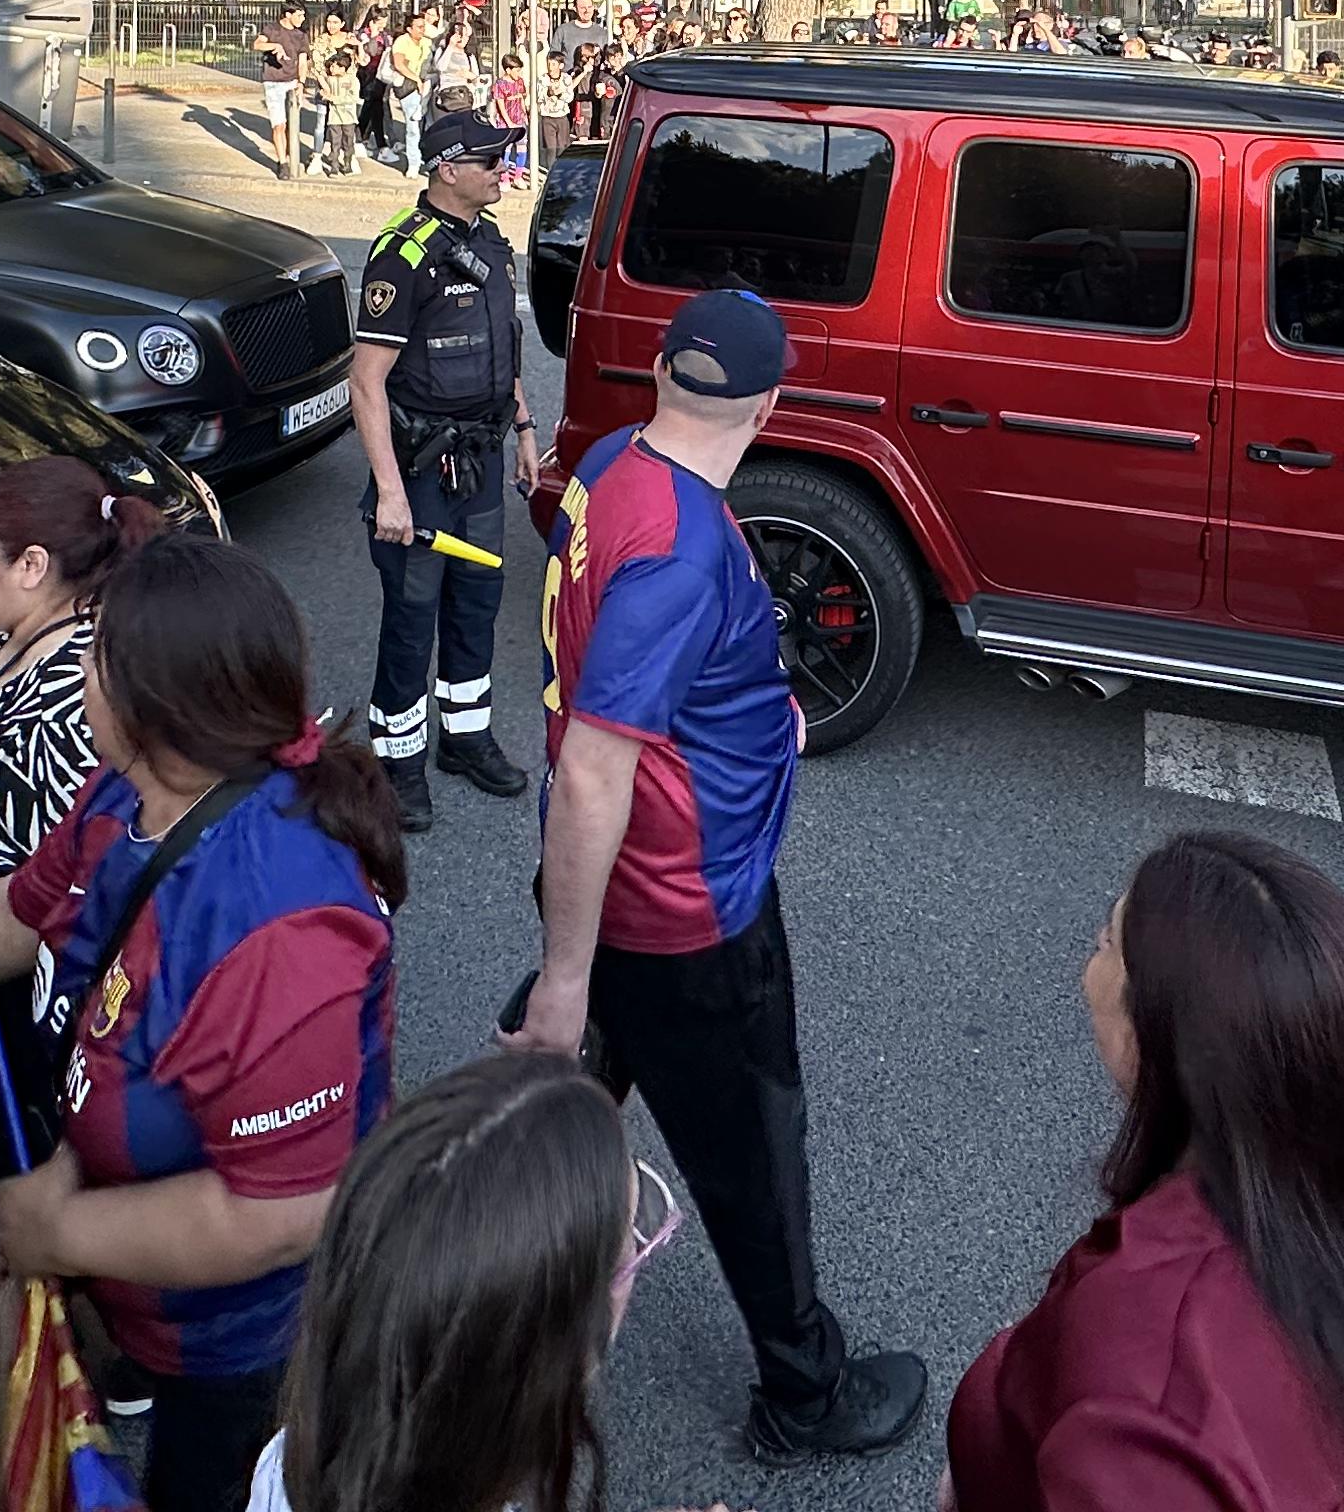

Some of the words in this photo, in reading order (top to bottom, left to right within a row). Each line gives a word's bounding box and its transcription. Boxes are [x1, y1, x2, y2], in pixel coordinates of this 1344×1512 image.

[293, 401, 311, 429] WE
[231, 1088, 329, 1138] AMBILIGHT
[330, 1082, 345, 1102] tv
